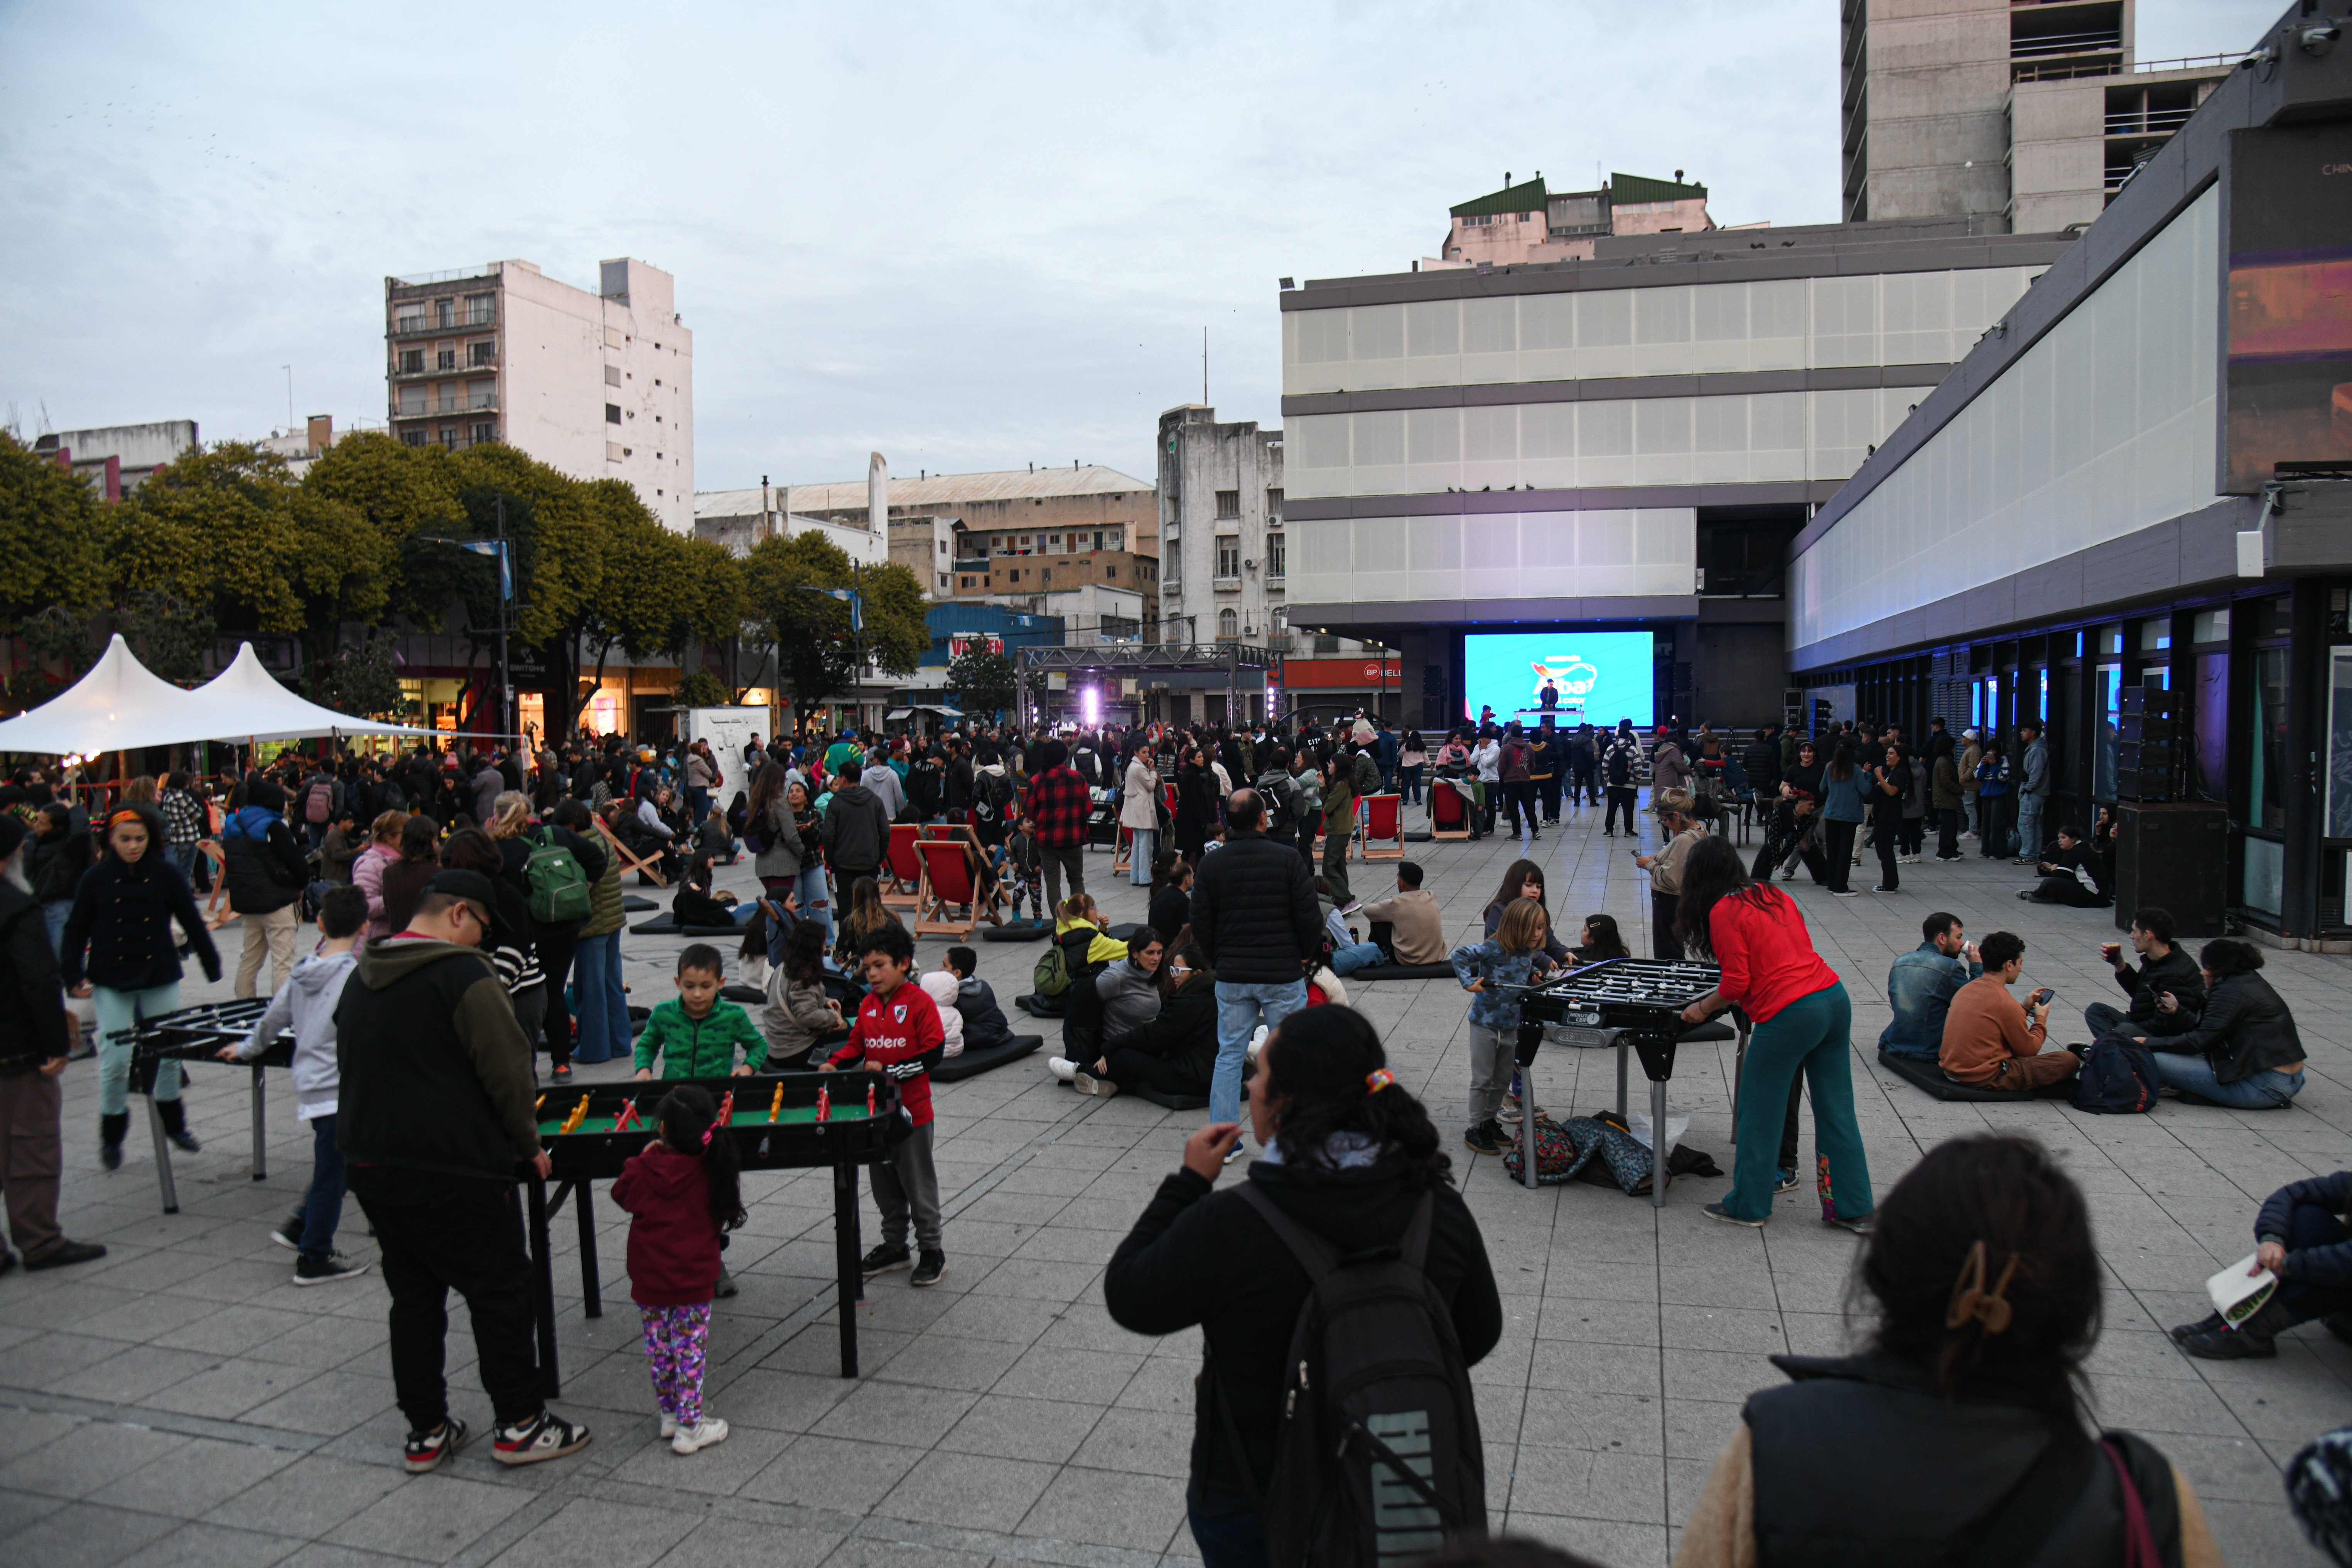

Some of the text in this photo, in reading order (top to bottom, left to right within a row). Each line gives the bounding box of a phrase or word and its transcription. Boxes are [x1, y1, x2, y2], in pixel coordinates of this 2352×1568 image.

[1533, 677, 1586, 694] Alba
[865, 1035, 906, 1048] codere
[1367, 1410, 1444, 1568] UMA
